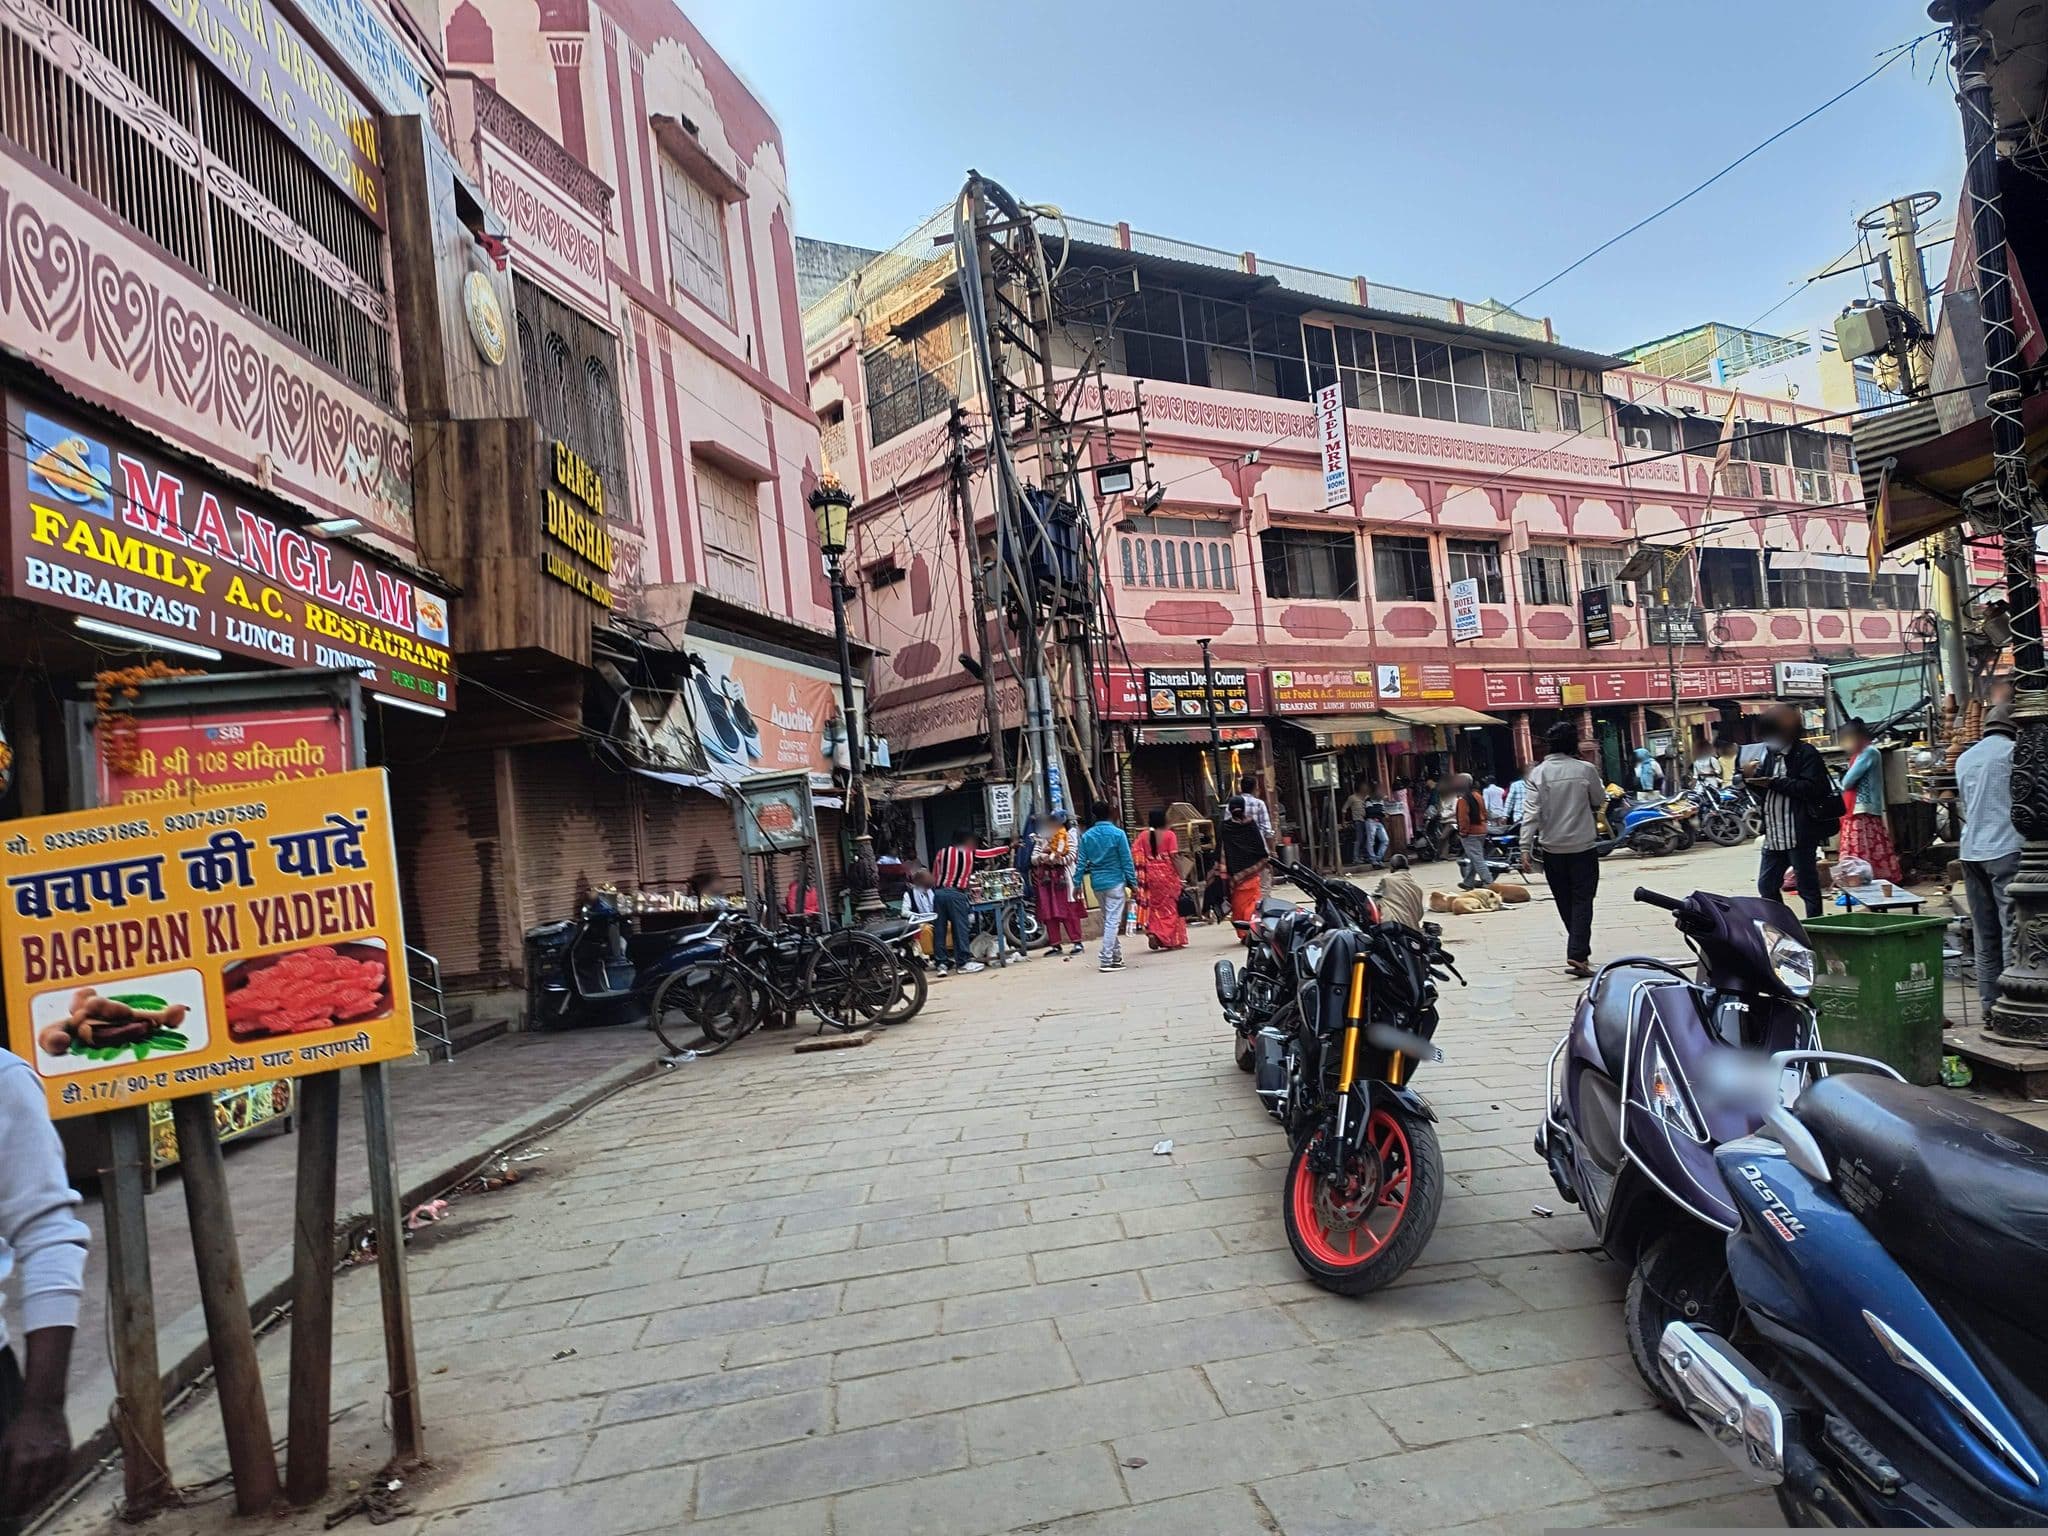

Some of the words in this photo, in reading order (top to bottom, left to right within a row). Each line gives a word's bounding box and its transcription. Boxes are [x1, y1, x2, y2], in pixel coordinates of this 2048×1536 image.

[389, 41, 424, 103] INDIA
[274, 18, 378, 166] DARSHAN
[308, 115, 377, 214] ROOMS
[1322, 388, 1338, 441] HOTEL
[1325, 440, 1342, 472] MRK
[556, 439, 604, 516] GANGA
[1327, 479, 1345, 489] ROOMS
[118, 453, 415, 633] MANGLAM
[547, 489, 614, 574] DARSHAN
[547, 551, 576, 588] LUXURY
[29, 503, 212, 593] FAMILY
[225, 575, 293, 623] A.C.
[304, 602, 450, 675] RESTAURANT
[1453, 596, 1474, 608] HOTEL
[25, 556, 200, 631] BREAKFAST
[225, 617, 296, 658] LUNCH
[315, 643, 378, 681] DINNER
[1457, 606, 1473, 616] MRK
[1661, 623, 1680, 631] HTEL
[1149, 671, 1190, 686] Banarasi
[1191, 671, 1214, 686] Dos
[1215, 671, 1246, 686] Corner
[1293, 671, 1354, 688] Manglam
[1293, 689, 1312, 699] Food
[1313, 689, 1319, 699] &
[1336, 688, 1374, 699] Restaurant
[771, 703, 814, 736] Aqualite
[1323, 702, 1345, 710] LUNCH
[1350, 701, 1375, 710] DINNER
[218, 725, 245, 740] SBI
[160, 746, 191, 775] श्री
[196, 751, 228, 774] 108
[164, 803, 268, 833] 9307497596
[7, 855, 166, 919] बचपन
[180, 831, 255, 893] की
[269, 810, 369, 879] यादें
[21, 911, 193, 984] BACHPAN
[202, 903, 241, 955] KI
[250, 882, 378, 947] YADEIN
[1724, 1002, 1750, 1012] TVS
[261, 1049, 294, 1067] घाट
[300, 1031, 372, 1061] वाराणसी
[1764, 1210, 1794, 1240] PRIME
